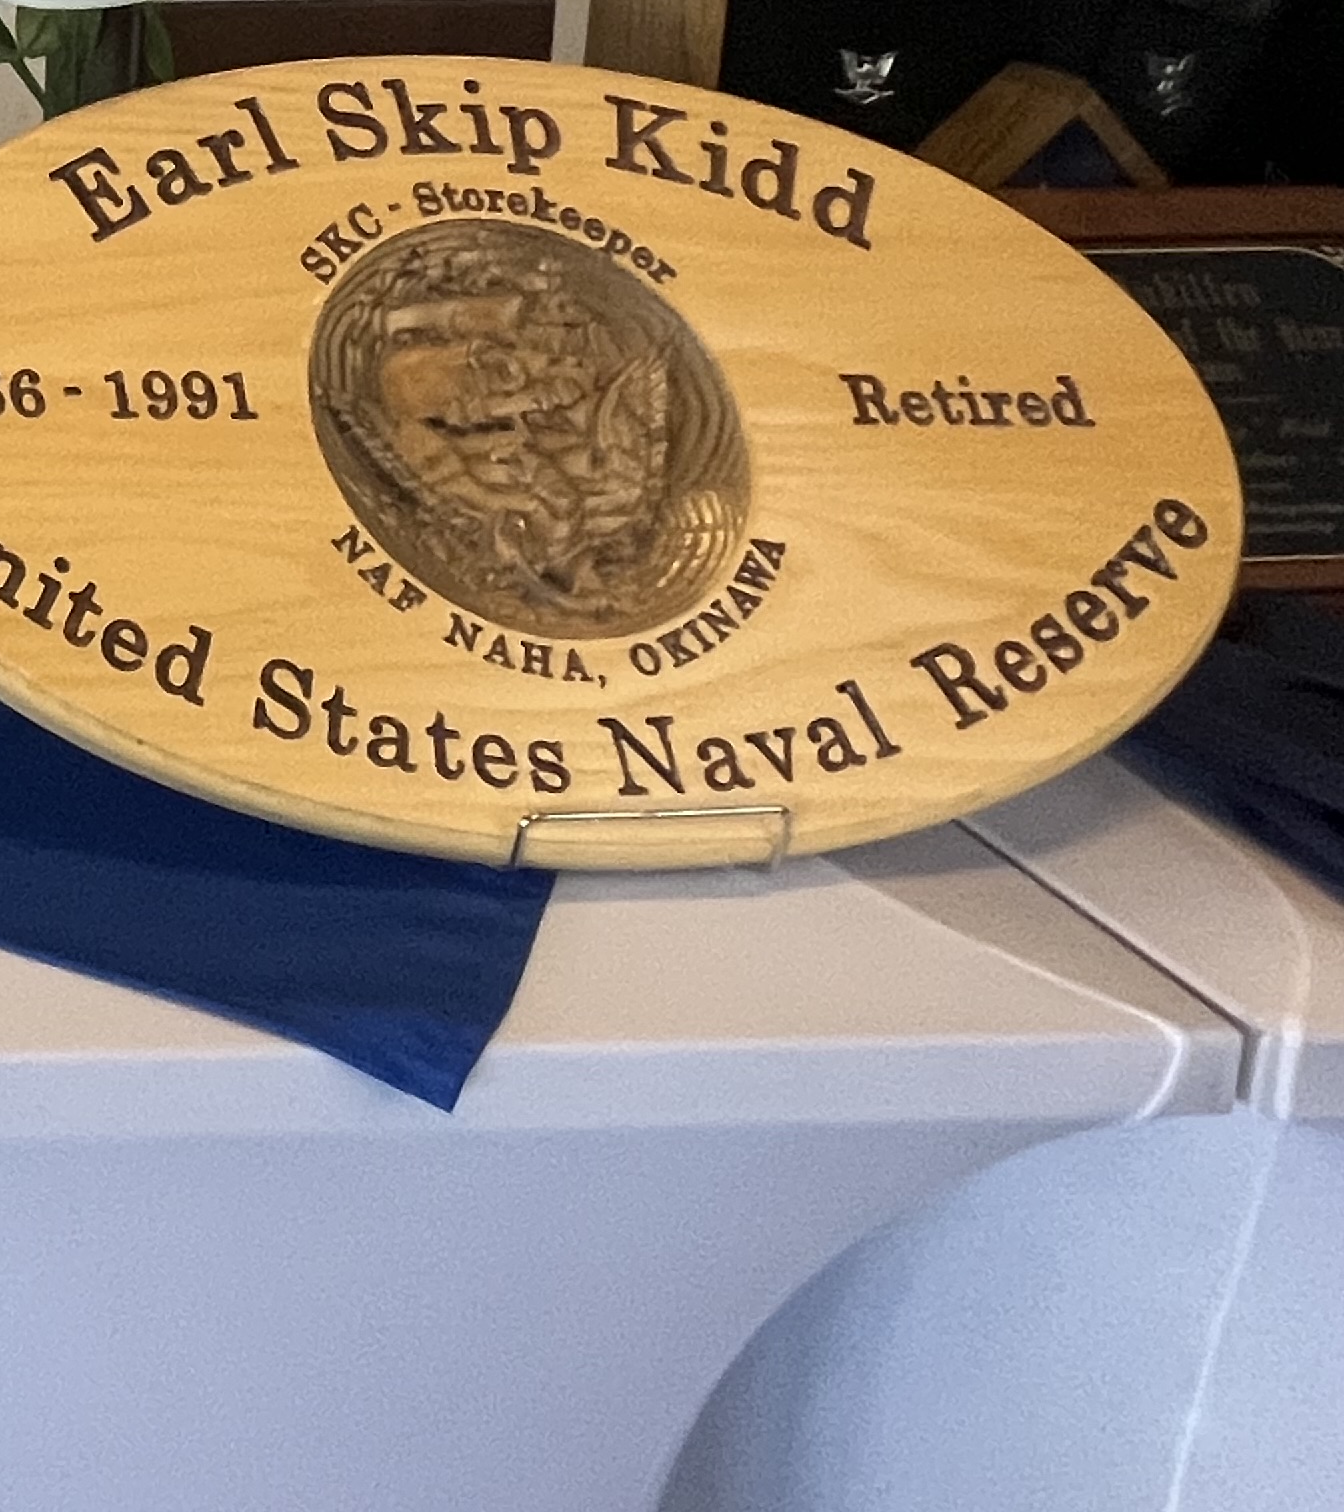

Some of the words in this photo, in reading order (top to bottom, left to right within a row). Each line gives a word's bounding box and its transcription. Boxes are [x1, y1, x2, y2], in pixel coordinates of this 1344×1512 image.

[49, 97, 299, 242] Earl
[318, 79, 561, 175] Skip
[605, 95, 876, 251] Kidd
[300, 202, 385, 285] SKC
[413, 181, 678, 285] Storekeeper
[104, 369, 259, 421] 1991
[838, 373, 1097, 429] Retired
[252, 658, 572, 794] States
[597, 679, 902, 797] Naval
[910, 498, 1209, 731] Reserve
[330, 525, 428, 614] NAF
[442, 612, 609, 689] NAHA,
[628, 538, 787, 678] OKINAWA
